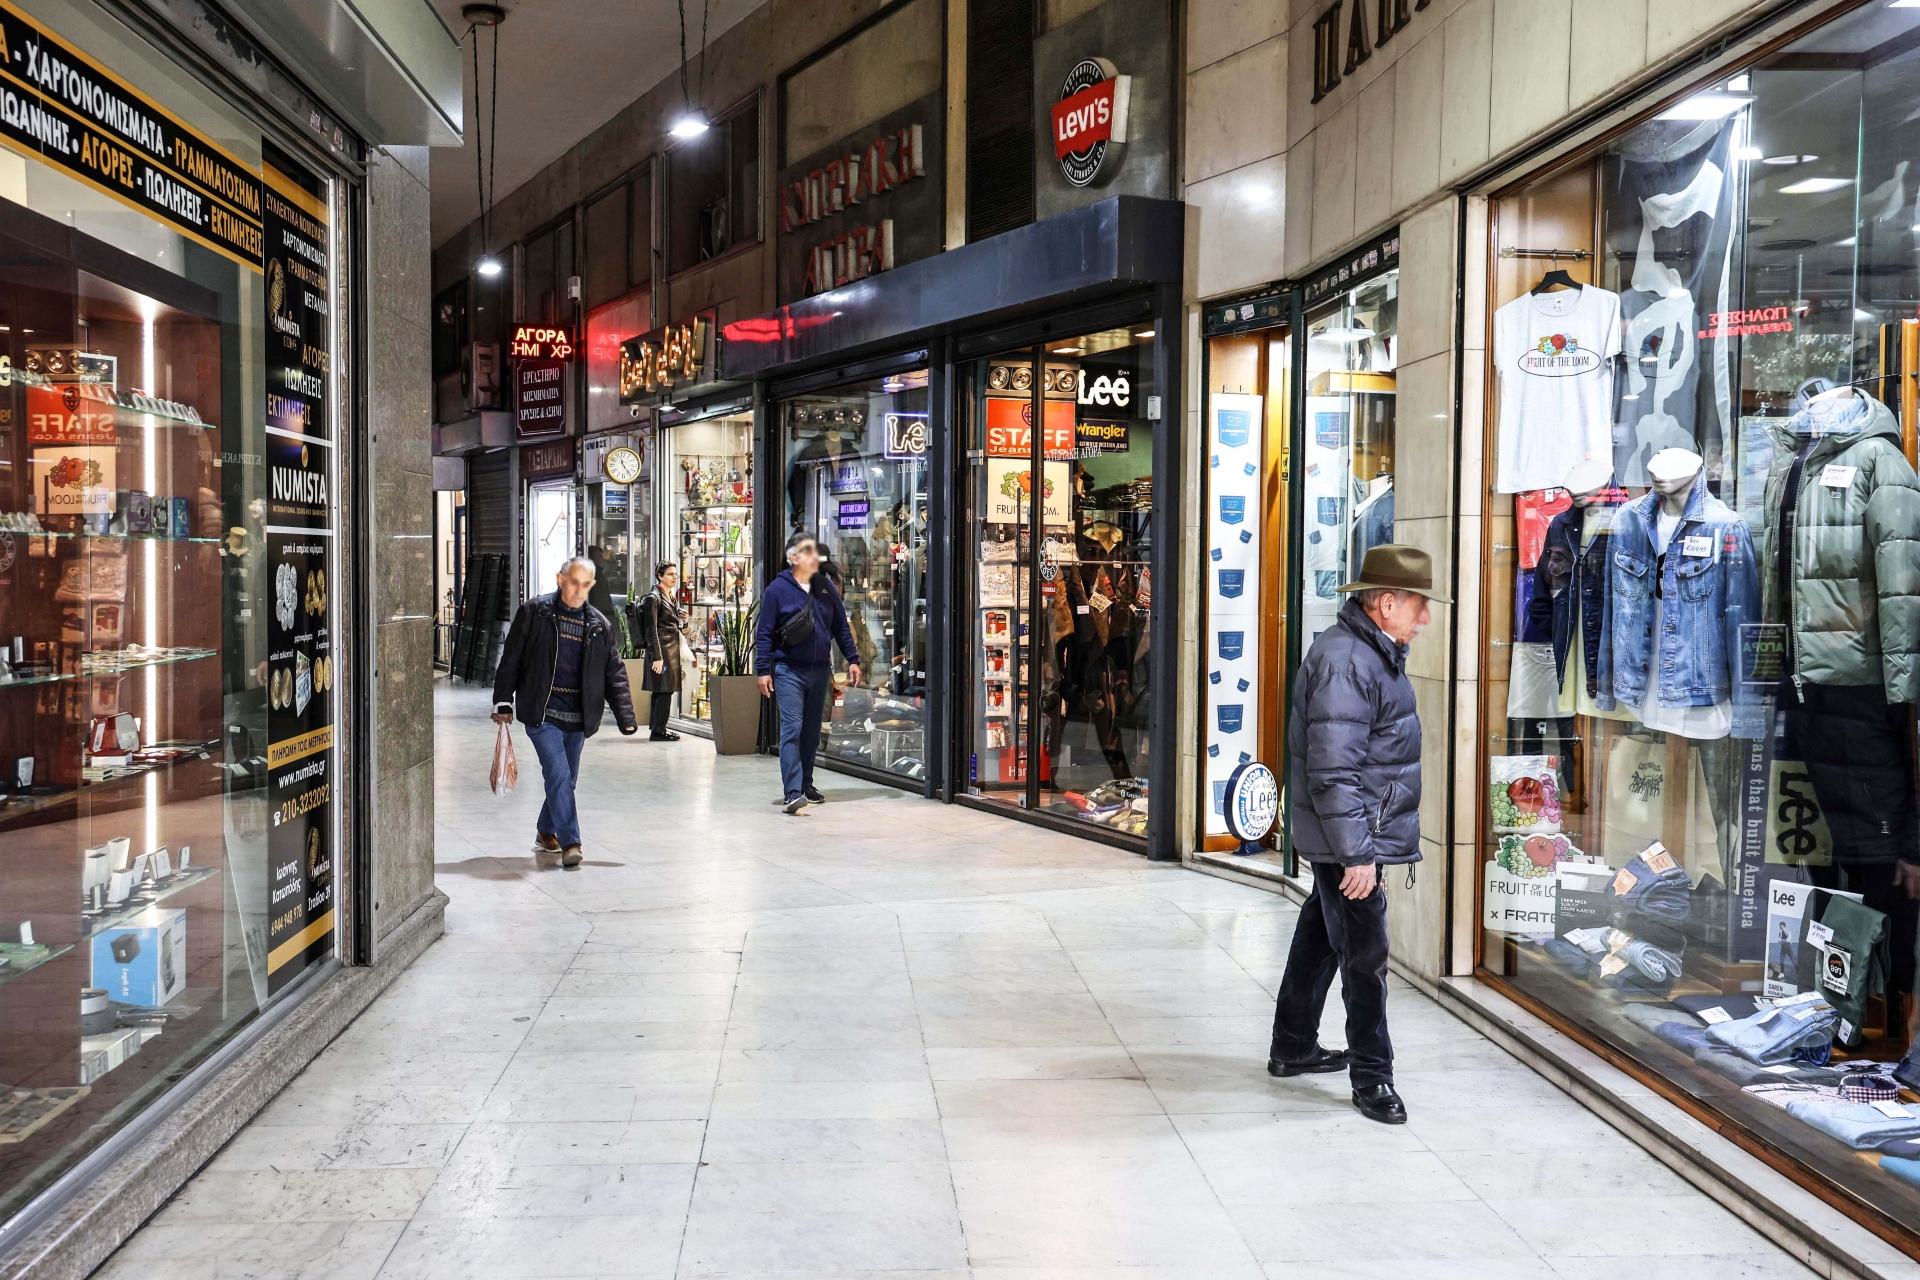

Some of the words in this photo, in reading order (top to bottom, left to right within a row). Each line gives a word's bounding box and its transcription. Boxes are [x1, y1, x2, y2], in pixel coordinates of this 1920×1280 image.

[26, 40, 165, 158] ΧΑΡΤΟΝΟΜΙΣΜΑΤΑ
[175, 137, 260, 216] ΓΡΑΜΜΑΤΟΣΗΜΑ
[780, 124, 922, 233] ΚΥΠΡΙΑΚΗ
[81, 132, 134, 189] ΑΓΟΡΕΣ
[145, 167, 202, 225] ΠΩΛΗΣΕΙΣ
[211, 205, 263, 258] ΕΚΤΙΜΗΣΕΙΣ
[803, 219, 894, 295] ΑΓΟΡΑ
[515, 327, 567, 344] ΑΓΟΡΑ
[303, 343, 330, 373] ΑΓΟΡΕΣ
[550, 344, 572, 358] ΧΡ
[1527, 357, 1546, 367] FRUIT
[1547, 357, 1556, 367] OF
[1557, 356, 1570, 367] THE
[1572, 355, 1590, 366] LOOM
[285, 366, 322, 399] ΠΩΛΗΣΕΙΣ
[523, 367, 560, 385] ΕΡΓΑΣΤΗΡΙΟ
[1077, 370, 1130, 407] Lee
[268, 393, 311, 426] ΕΚΤΙΜΗΣΕΙΣ
[523, 387, 560, 403] ΚΟΣΜΗΜΑΤΩΝ
[545, 405, 562, 418] ΑΣΗΜΙ
[1076, 422, 1126, 439] Wrangler
[527, 448, 567, 471] ΤΑΞΙΑΡΧΗΣ
[1081, 445, 1102, 459] ΑΓΟΡΑ
[272, 465, 327, 505] NUMISTA
[1751, 738, 1764, 772] eans
[278, 759, 326, 789] www.numista.gr
[1241, 769, 1261, 798] UNION
[281, 783, 330, 823] 210-3232092
[1249, 791, 1273, 812] Lee
[1748, 778, 1765, 812] that
[1777, 770, 1820, 856] Lee
[1745, 819, 1762, 857] built
[1490, 881, 1529, 895] FRUIT
[1741, 863, 1760, 928] America
[1773, 890, 1796, 906] Lee
